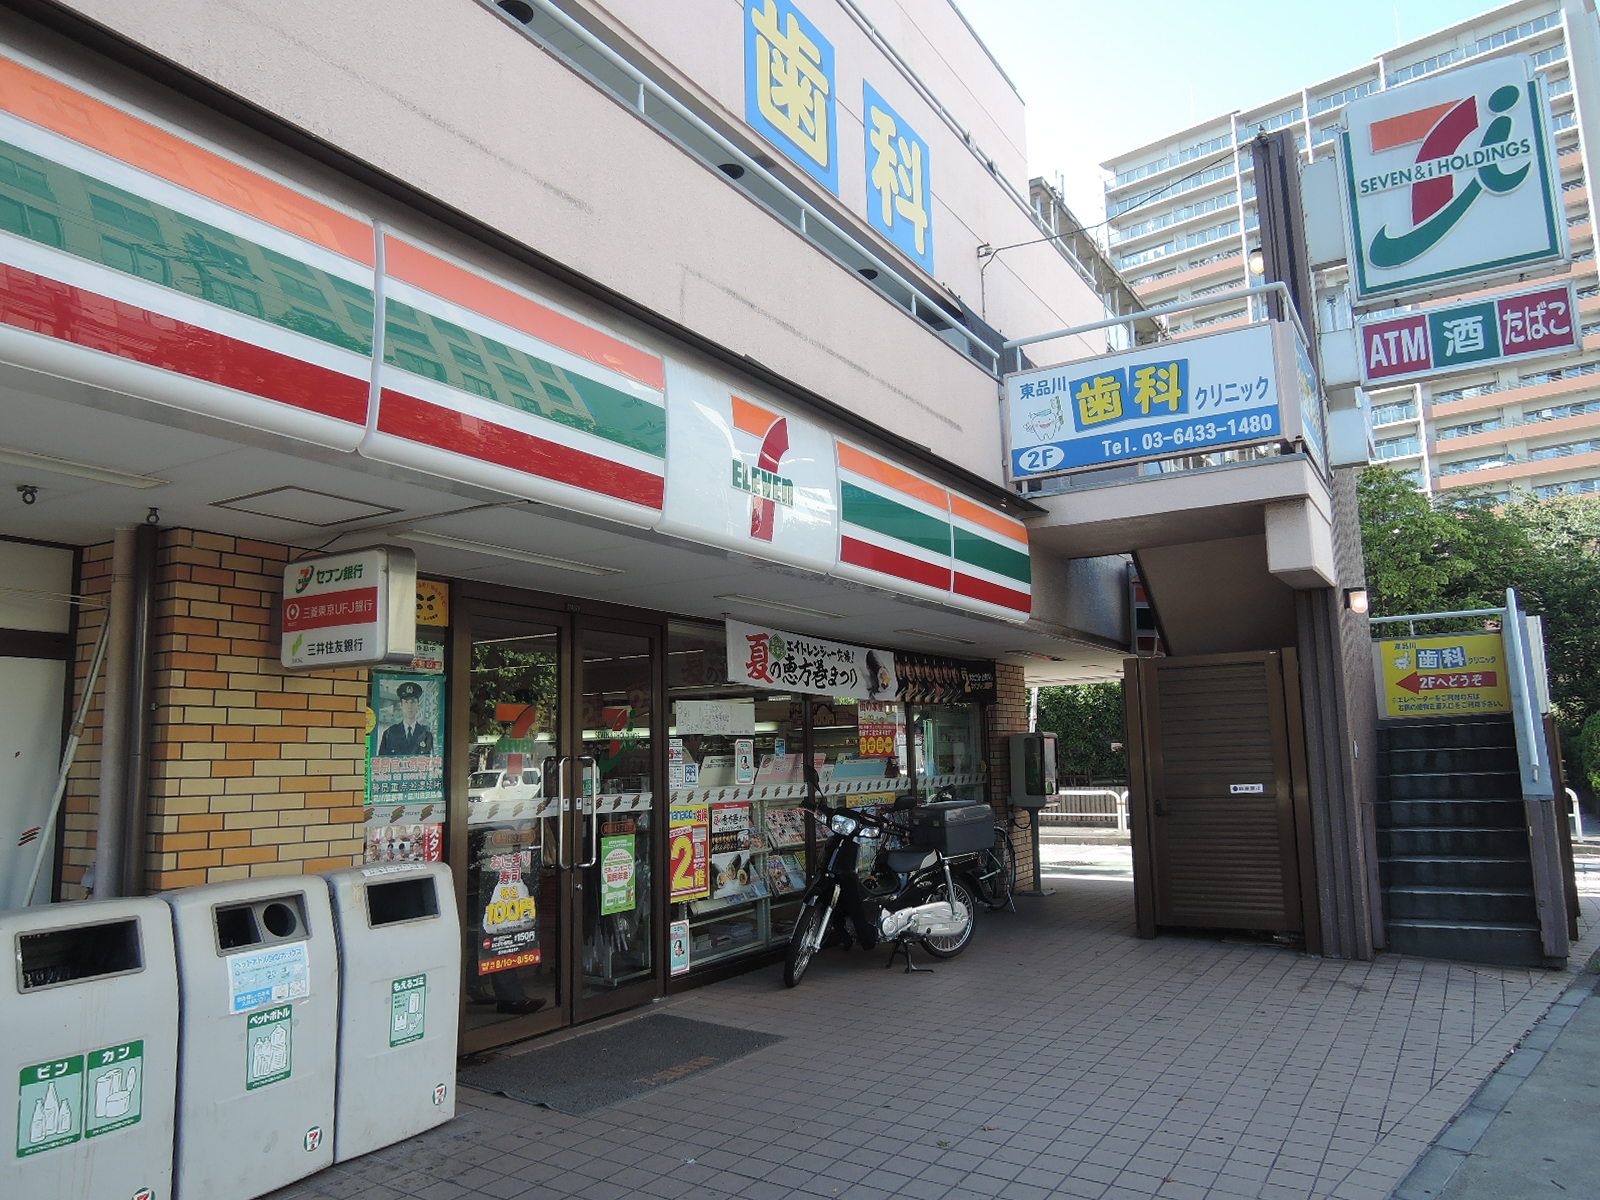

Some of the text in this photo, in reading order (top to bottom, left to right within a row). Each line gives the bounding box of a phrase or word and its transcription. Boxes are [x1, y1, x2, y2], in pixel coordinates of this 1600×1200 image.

[752, 0, 928, 255] 歯科
[1439, 139, 1531, 174] HOLDINGS
[1370, 300, 1570, 369] ATM 酒 たばこ
[1020, 376, 1066, 400] 東品川
[1076, 362, 1182, 426] 歯科
[1195, 376, 1269, 410] クリニック
[1102, 413, 1272, 457] Tel. 03-6433-1480
[1028, 450, 1055, 469] 2F
[316, 564, 364, 584] セブン銀行
[303, 600, 374, 619] 三菱東京UFJ銀行
[307, 638, 364, 656] 三井住友銀行
[1418, 647, 1465, 668] 歯科
[1420, 674, 1482, 689] 2Fへどうぞ
[490, 850, 531, 870] おにぎり
[671, 835, 694, 891] 2
[486, 896, 536, 926] 100円
[394, 977, 424, 991] もえるゴミ
[250, 1007, 290, 1024] ペットボトル
[102, 1047, 130, 1063] カン
[37, 1062, 69, 1079] ビン
